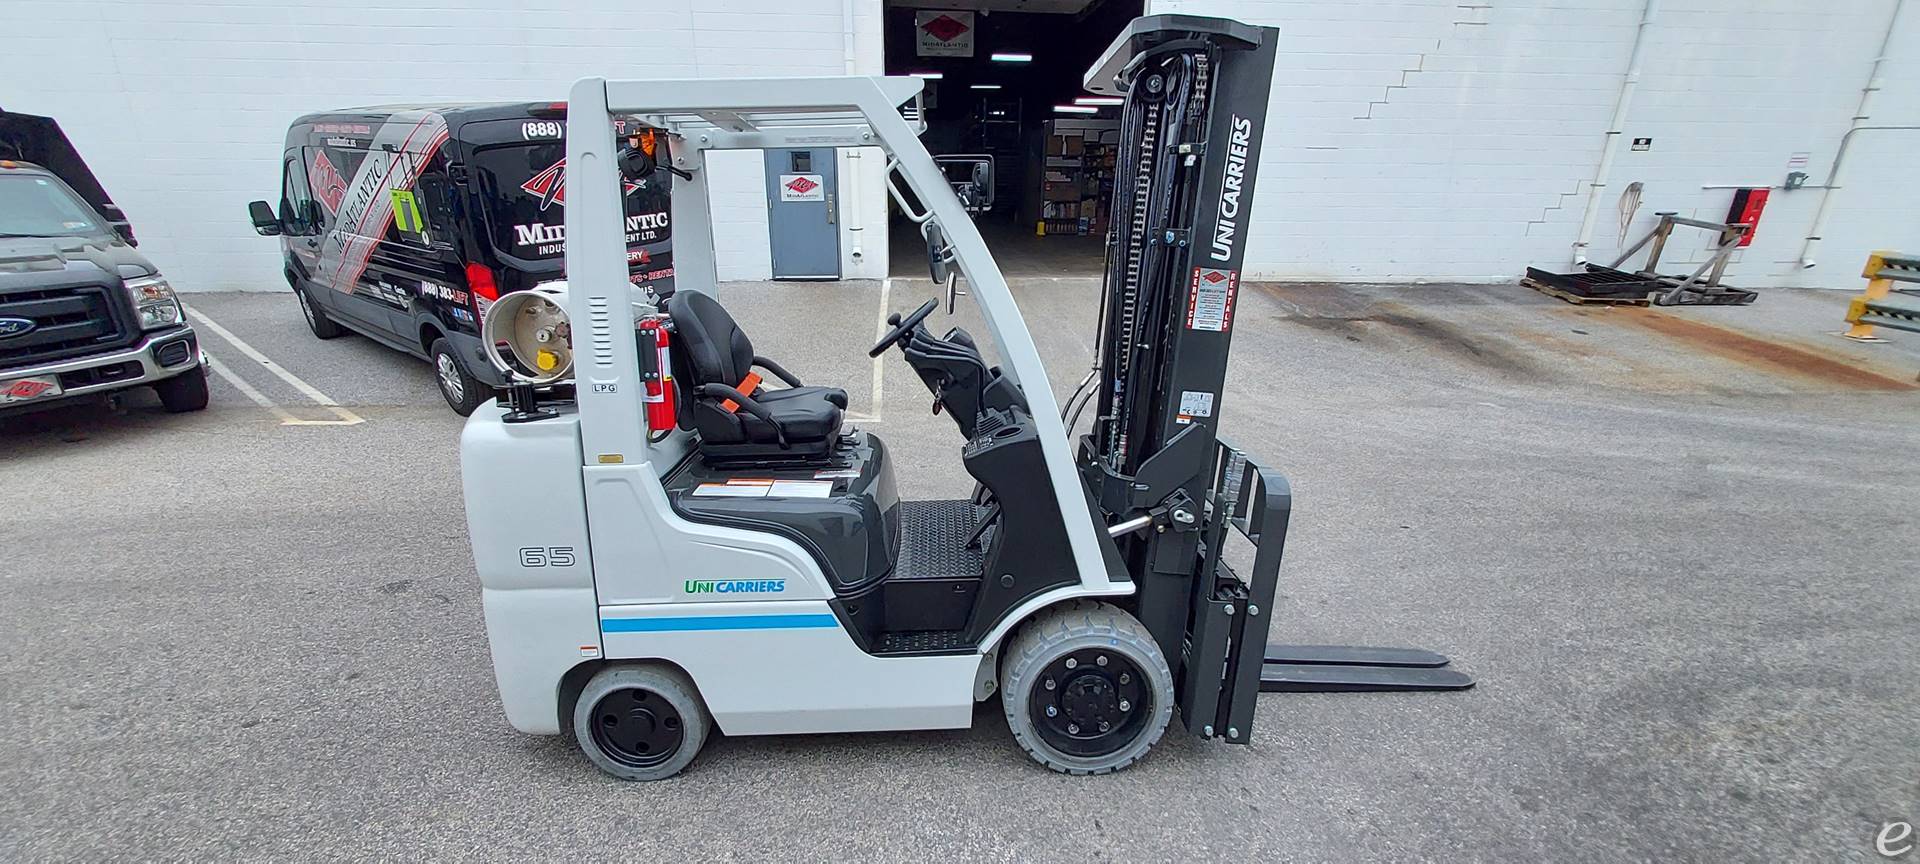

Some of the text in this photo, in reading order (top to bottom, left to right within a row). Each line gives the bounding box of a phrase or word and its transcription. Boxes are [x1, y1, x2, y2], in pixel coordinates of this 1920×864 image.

[522, 122, 562, 141] (888)
[641, 230, 657, 241] LTD.
[1188, 270, 1200, 326] SERVICE
[1222, 273, 1236, 329] RENTALS
[519, 547, 576, 568] 65
